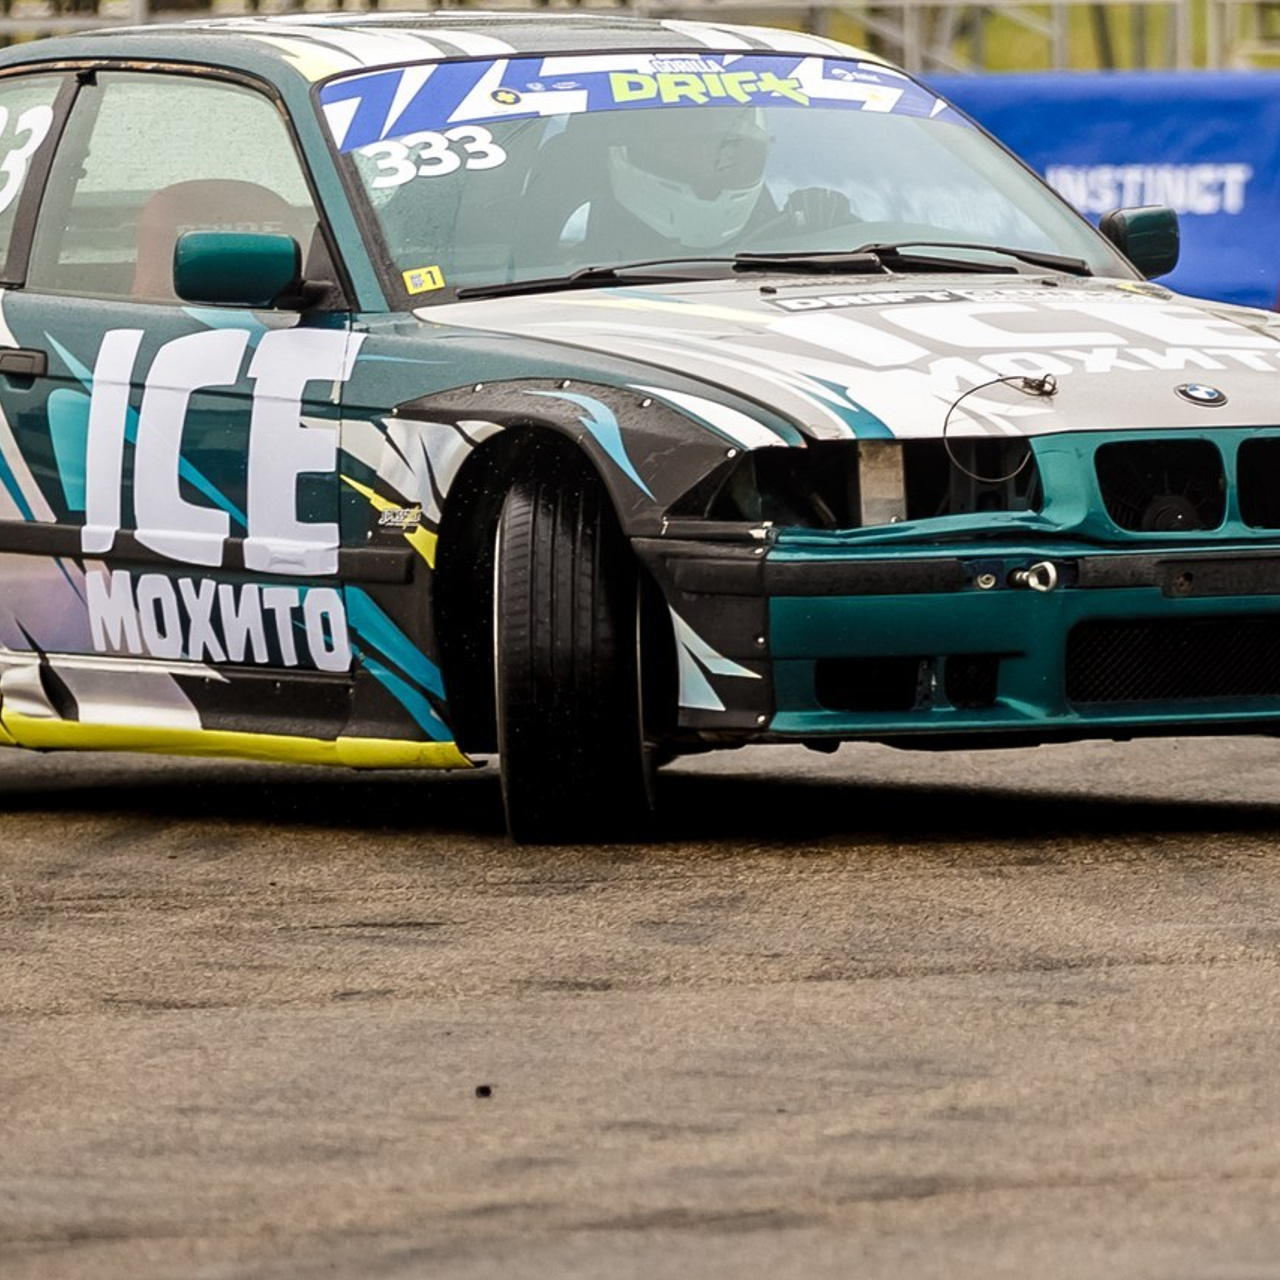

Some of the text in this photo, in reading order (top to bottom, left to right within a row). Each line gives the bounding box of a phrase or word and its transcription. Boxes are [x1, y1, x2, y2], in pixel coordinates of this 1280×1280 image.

[609, 71, 810, 106] DRIFT
[359, 124, 507, 189] 333
[776, 289, 953, 311] DRIFT
[81, 328, 367, 576] ICE
[84, 570, 352, 672] МОХИТО
